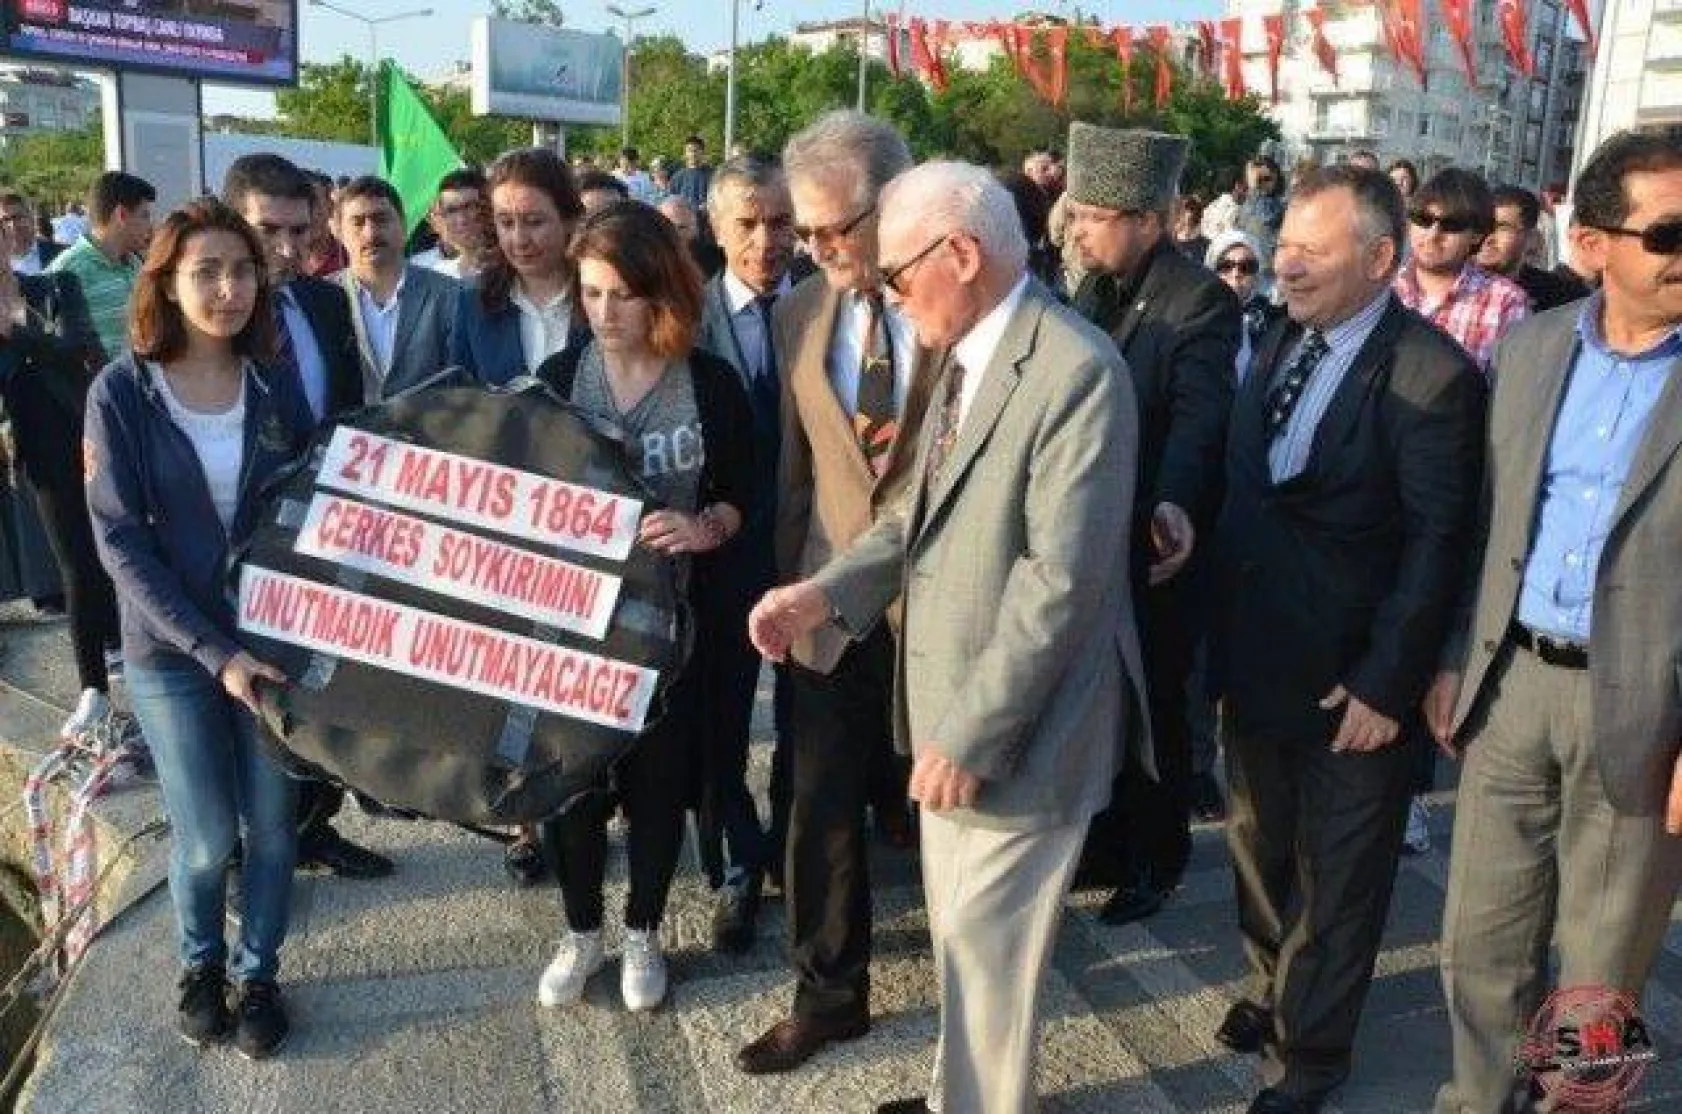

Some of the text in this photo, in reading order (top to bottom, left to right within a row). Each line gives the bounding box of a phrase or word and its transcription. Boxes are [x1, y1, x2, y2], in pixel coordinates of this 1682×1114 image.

[340, 435, 617, 544] 21 MAYIS 1864
[246, 575, 400, 658] UNUTMADIK
[433, 532, 601, 619] SOYKIRIMINI
